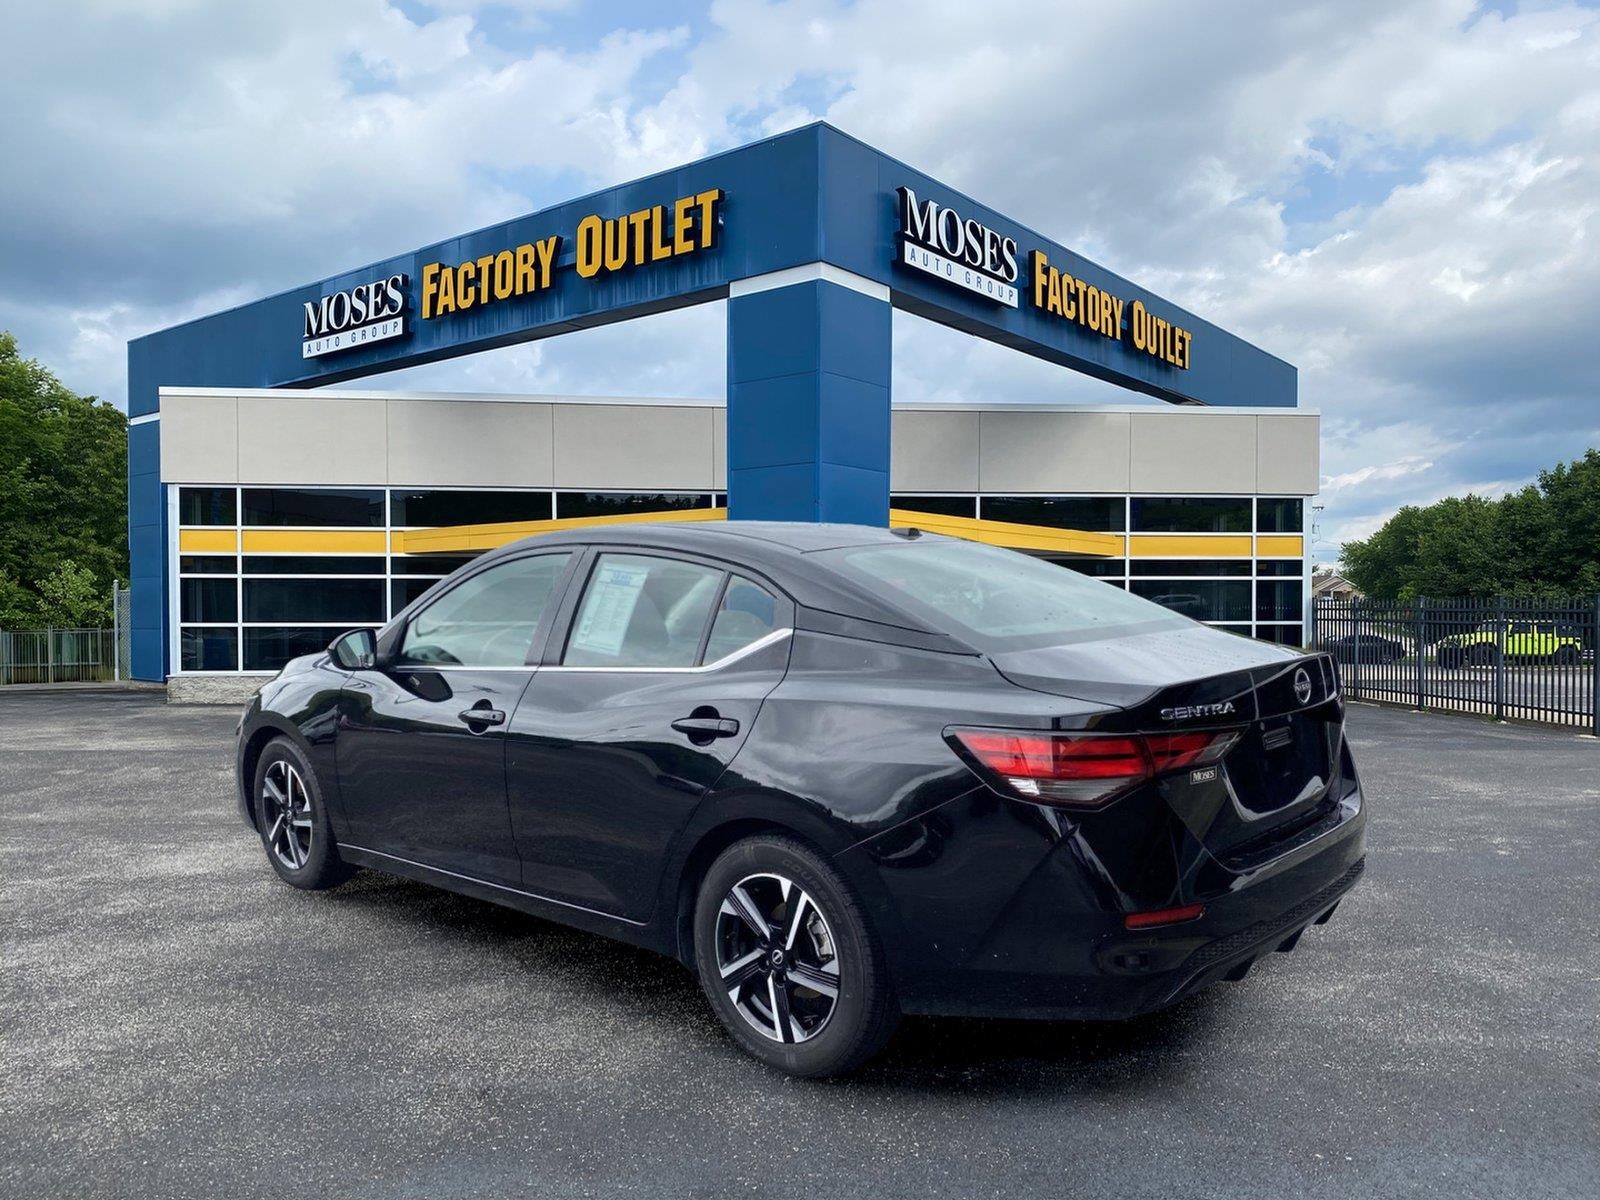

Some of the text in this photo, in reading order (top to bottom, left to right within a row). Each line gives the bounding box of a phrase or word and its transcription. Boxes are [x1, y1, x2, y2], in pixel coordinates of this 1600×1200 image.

[421, 188, 720, 320] FACTORY OUTLET
[903, 187, 1019, 283] MOSES
[909, 246, 1015, 302] AUTO GROUP
[303, 273, 403, 338] MOSES
[1034, 250, 1192, 370] FACTORY OUTLET
[306, 320, 399, 355] AUTO GROUP
[1160, 702, 1236, 720] SENTRA
[1192, 769, 1215, 782] MOSES
